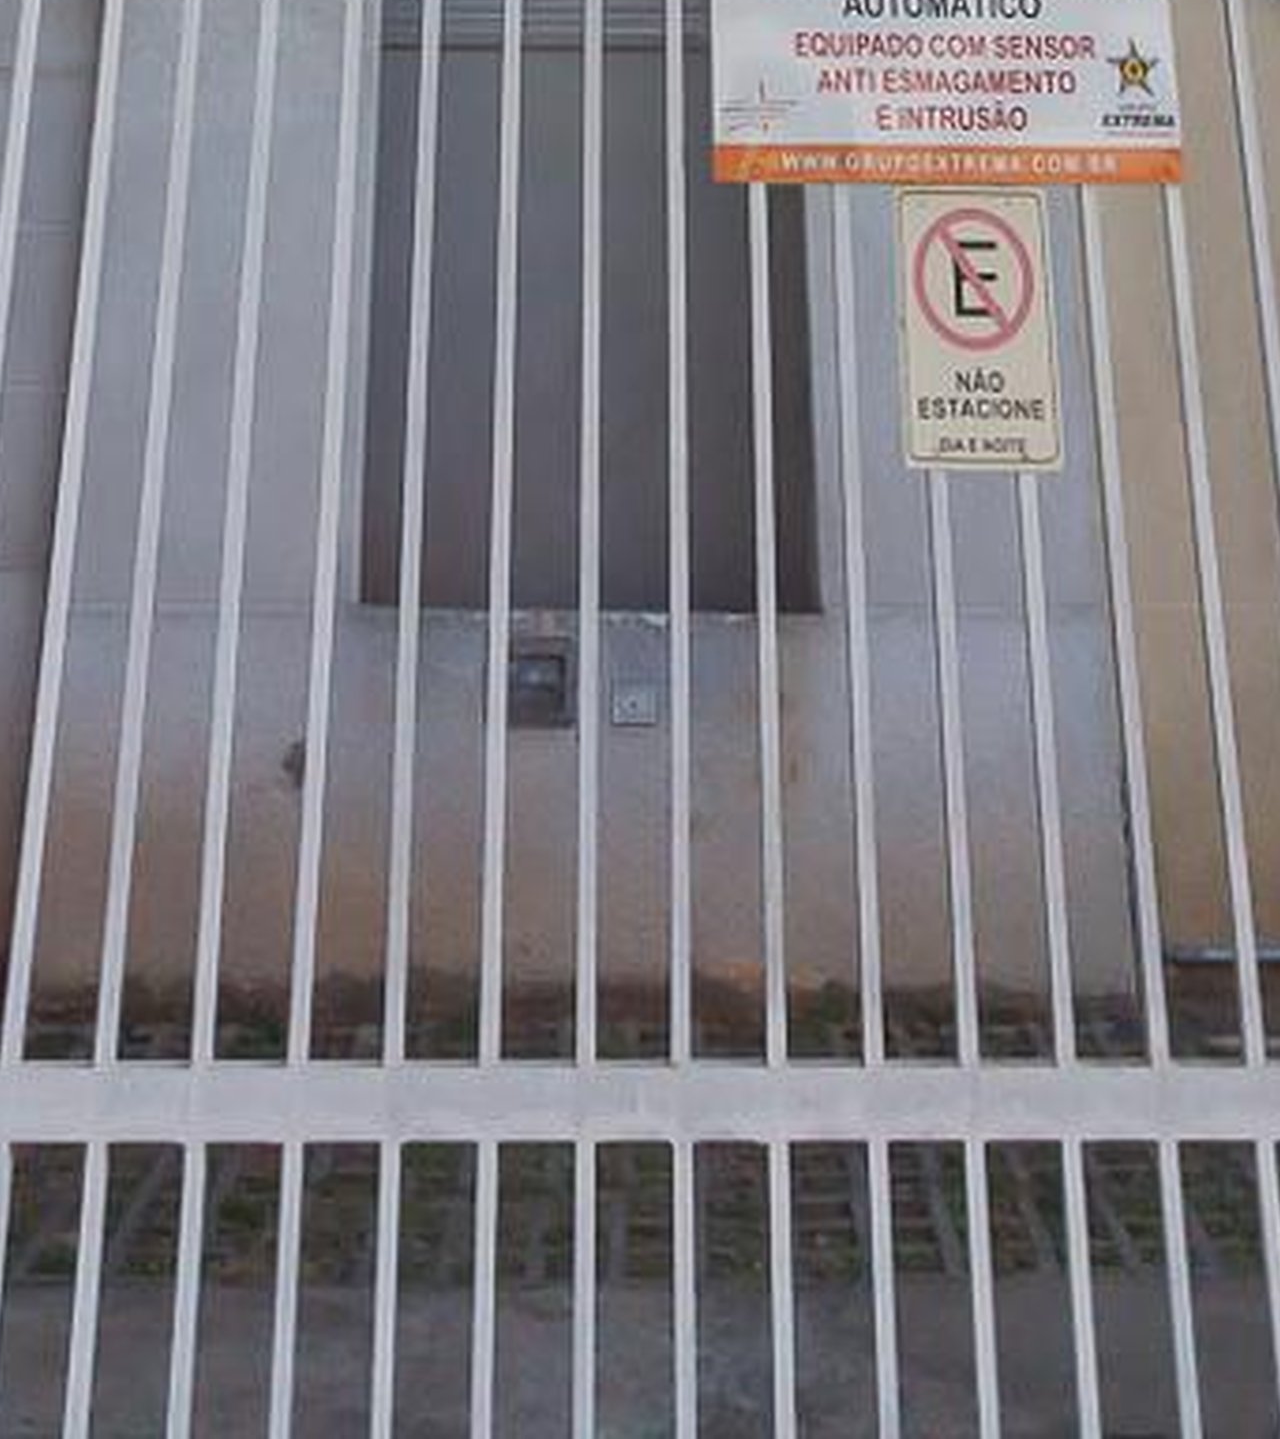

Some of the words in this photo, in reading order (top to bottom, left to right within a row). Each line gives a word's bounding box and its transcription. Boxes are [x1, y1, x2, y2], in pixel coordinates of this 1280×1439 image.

[794, 31, 922, 60] EQUIPADO
[930, 33, 988, 60] COM
[993, 33, 1096, 60] SENSOR
[816, 68, 880, 94] ANTI
[883, 69, 1077, 95] ESMAGAMENTO
[877, 106, 891, 132] E
[898, 99, 1028, 132] INTRUSÃO
[955, 366, 1005, 393] NÃO
[917, 397, 1045, 421] ESTACIONE
